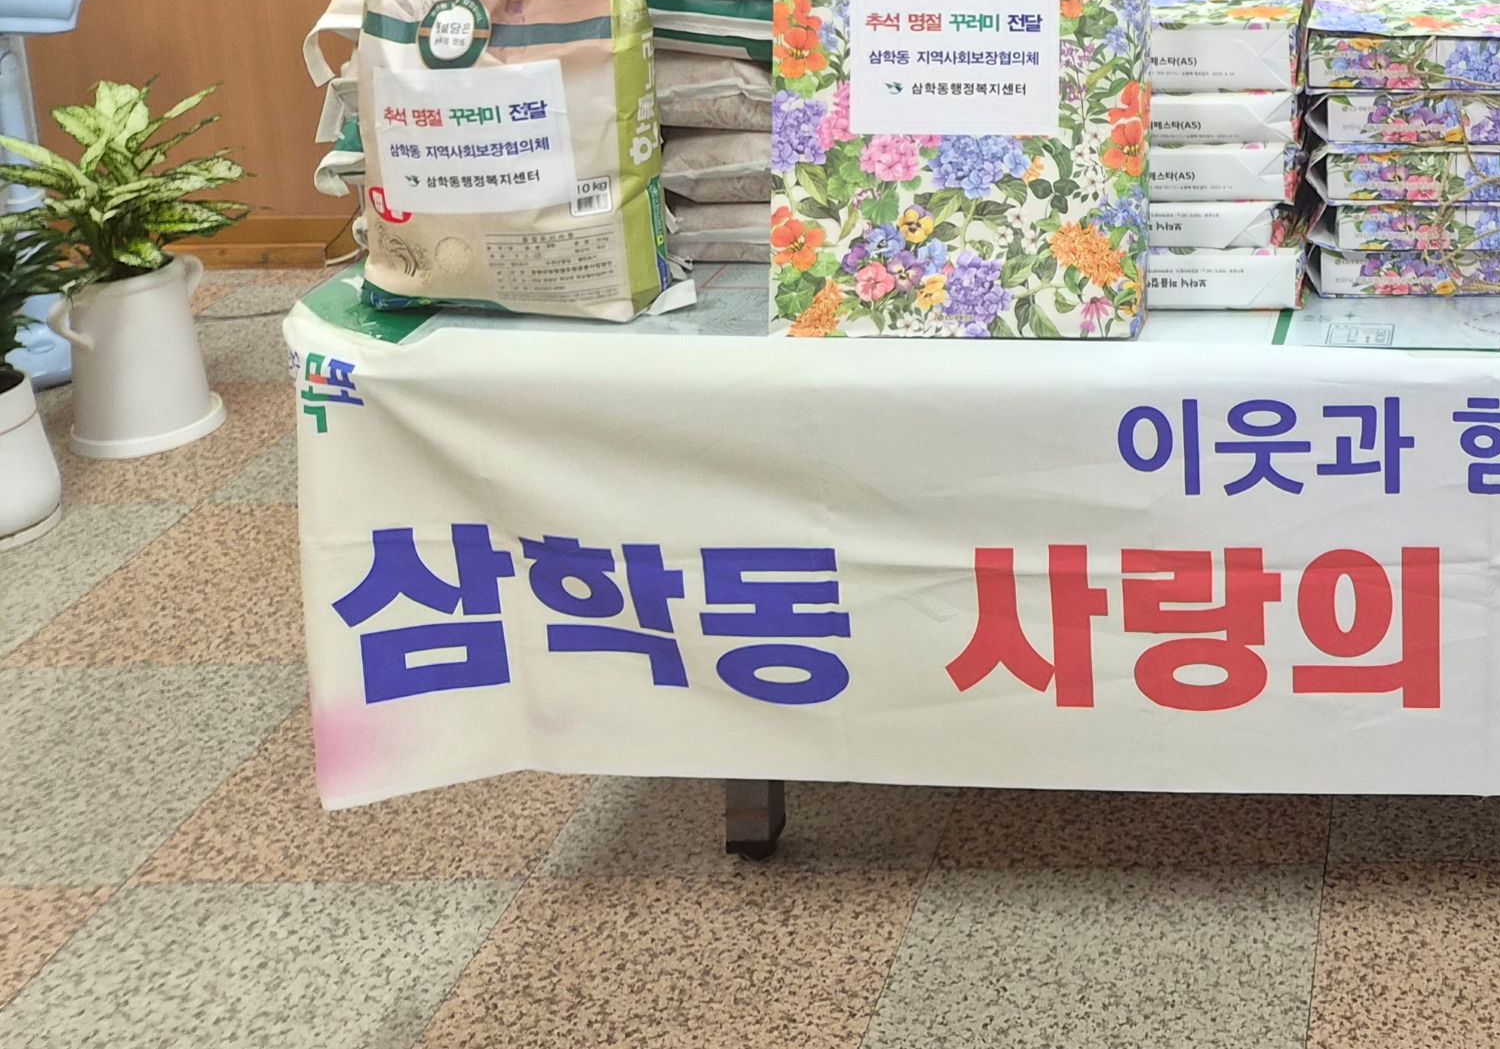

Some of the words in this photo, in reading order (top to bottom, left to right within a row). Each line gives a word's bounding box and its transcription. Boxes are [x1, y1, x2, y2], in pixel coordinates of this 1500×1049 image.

[865, 13, 900, 31] 추석
[908, 13, 942, 31] 명절
[949, 12, 1000, 32] 꾸러미
[1007, 13, 1043, 32] 전달
[869, 50, 910, 65] 삼학동
[917, 50, 1040, 66] 지역사회보장협의체
[912, 83, 1026, 96] 삼학동행정복지센터
[384, 106, 408, 126] 추석
[412, 107, 443, 127] 명절
[449, 105, 501, 126] 꾸러미
[509, 100, 547, 122] 전달
[390, 143, 421, 159] 삼학동
[426, 136, 550, 160] 지역사회보장협의체
[426, 169, 540, 189] 삼학동행정복지센터
[1116, 398, 1414, 497] 이웃과
[331, 523, 852, 706] 삼학동
[944, 544, 1440, 712] 사랑의
